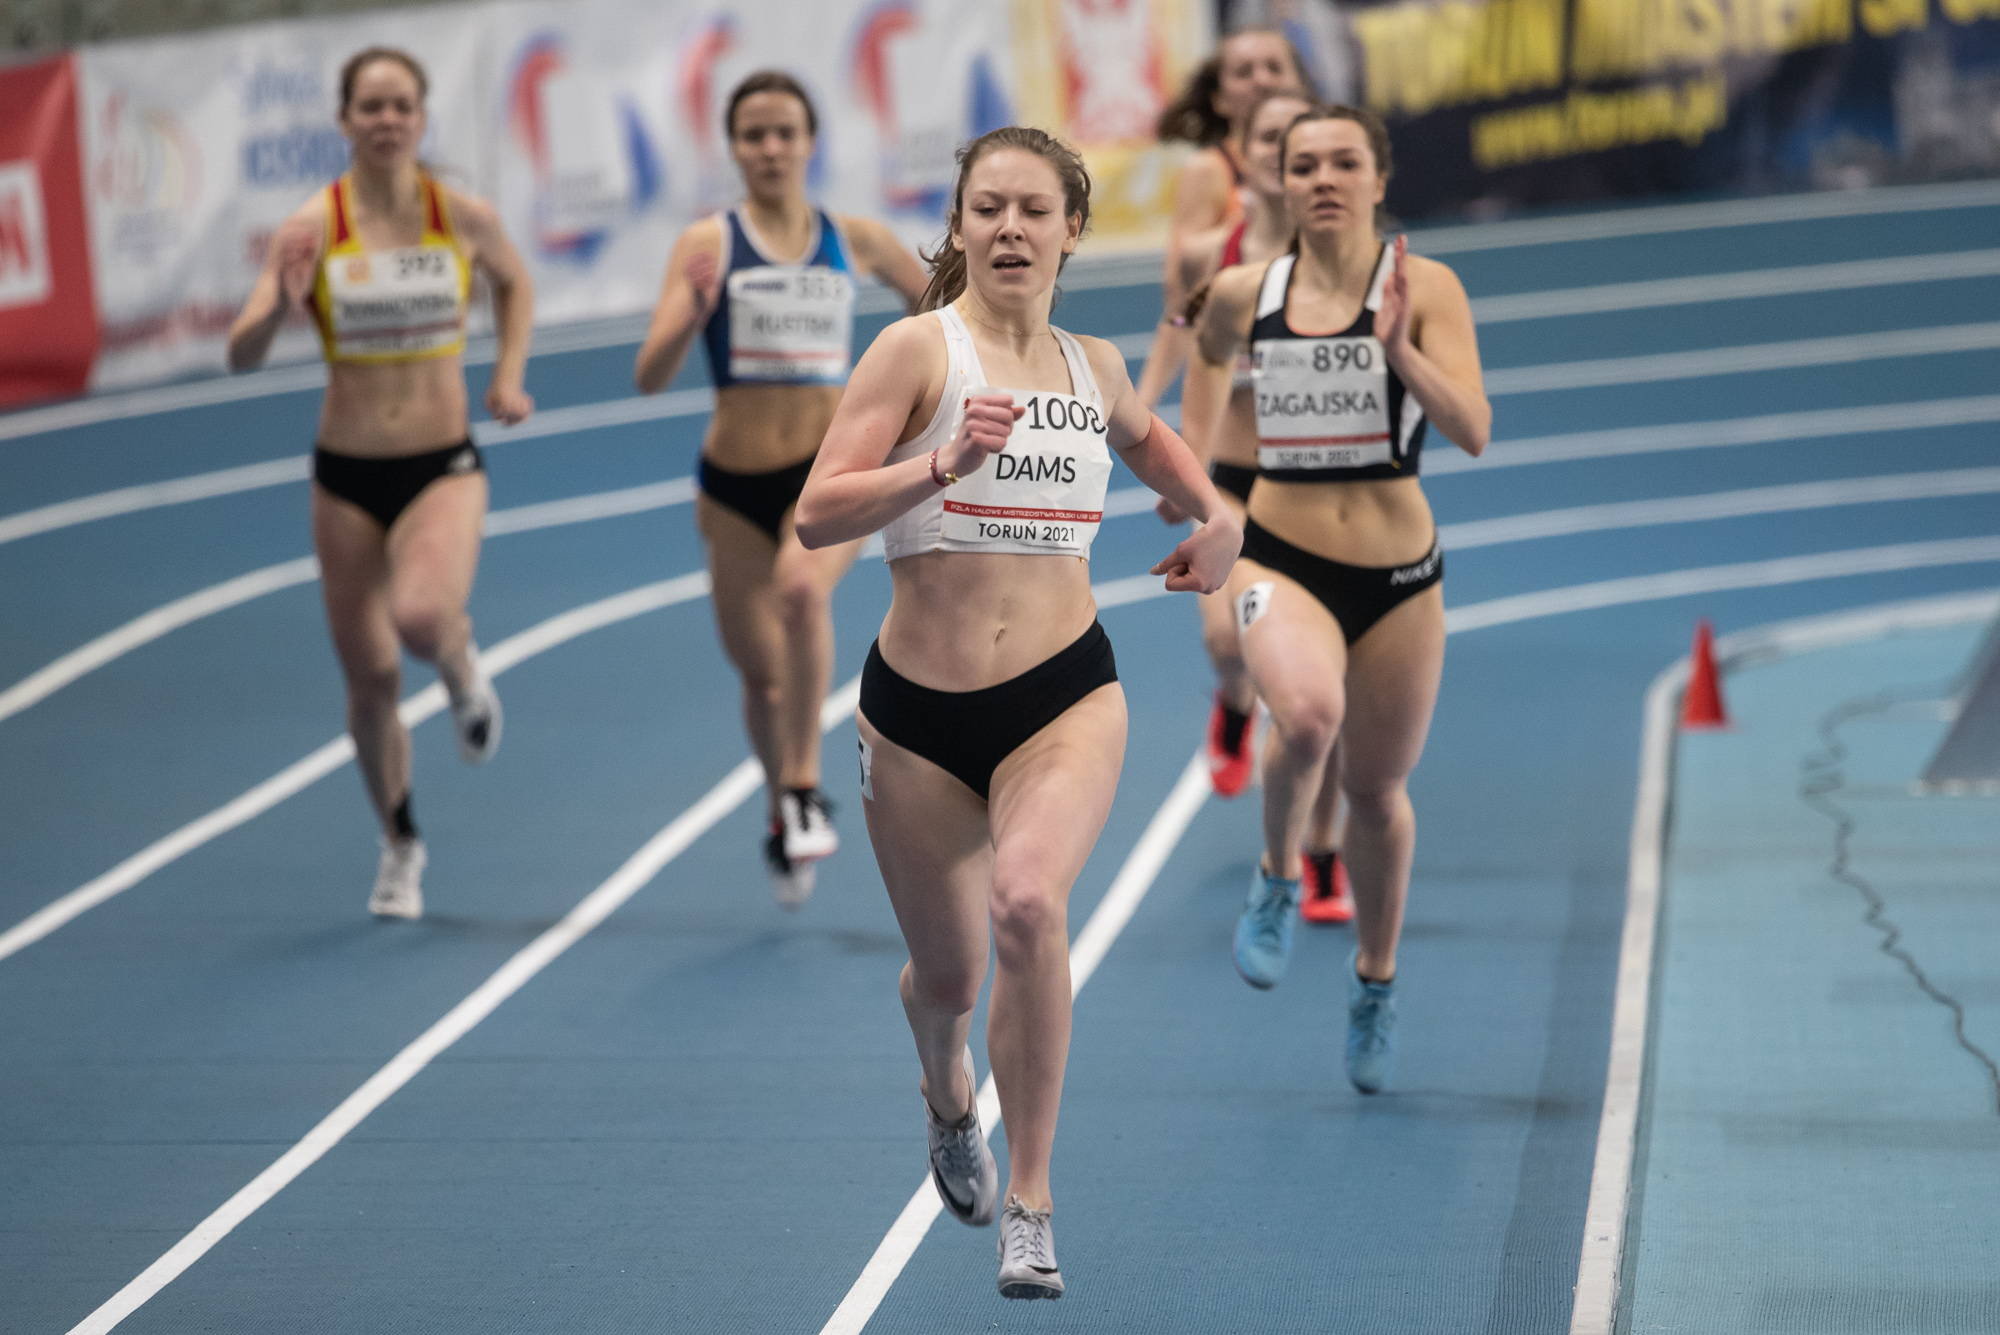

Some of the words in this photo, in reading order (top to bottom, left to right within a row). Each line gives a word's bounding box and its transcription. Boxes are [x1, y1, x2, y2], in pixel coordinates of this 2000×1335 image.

[1313, 343, 1372, 372] 890
[1258, 391, 1379, 418] ZAGAJSKA
[995, 453, 1076, 484] DAMS
[950, 503, 970, 513] PZLA
[971, 507, 1001, 516] HALOWE
[1003, 509, 1055, 519] MISTRZOSTWA
[978, 521, 1037, 540] TORUŃ
[1041, 526, 1075, 542] 2021
